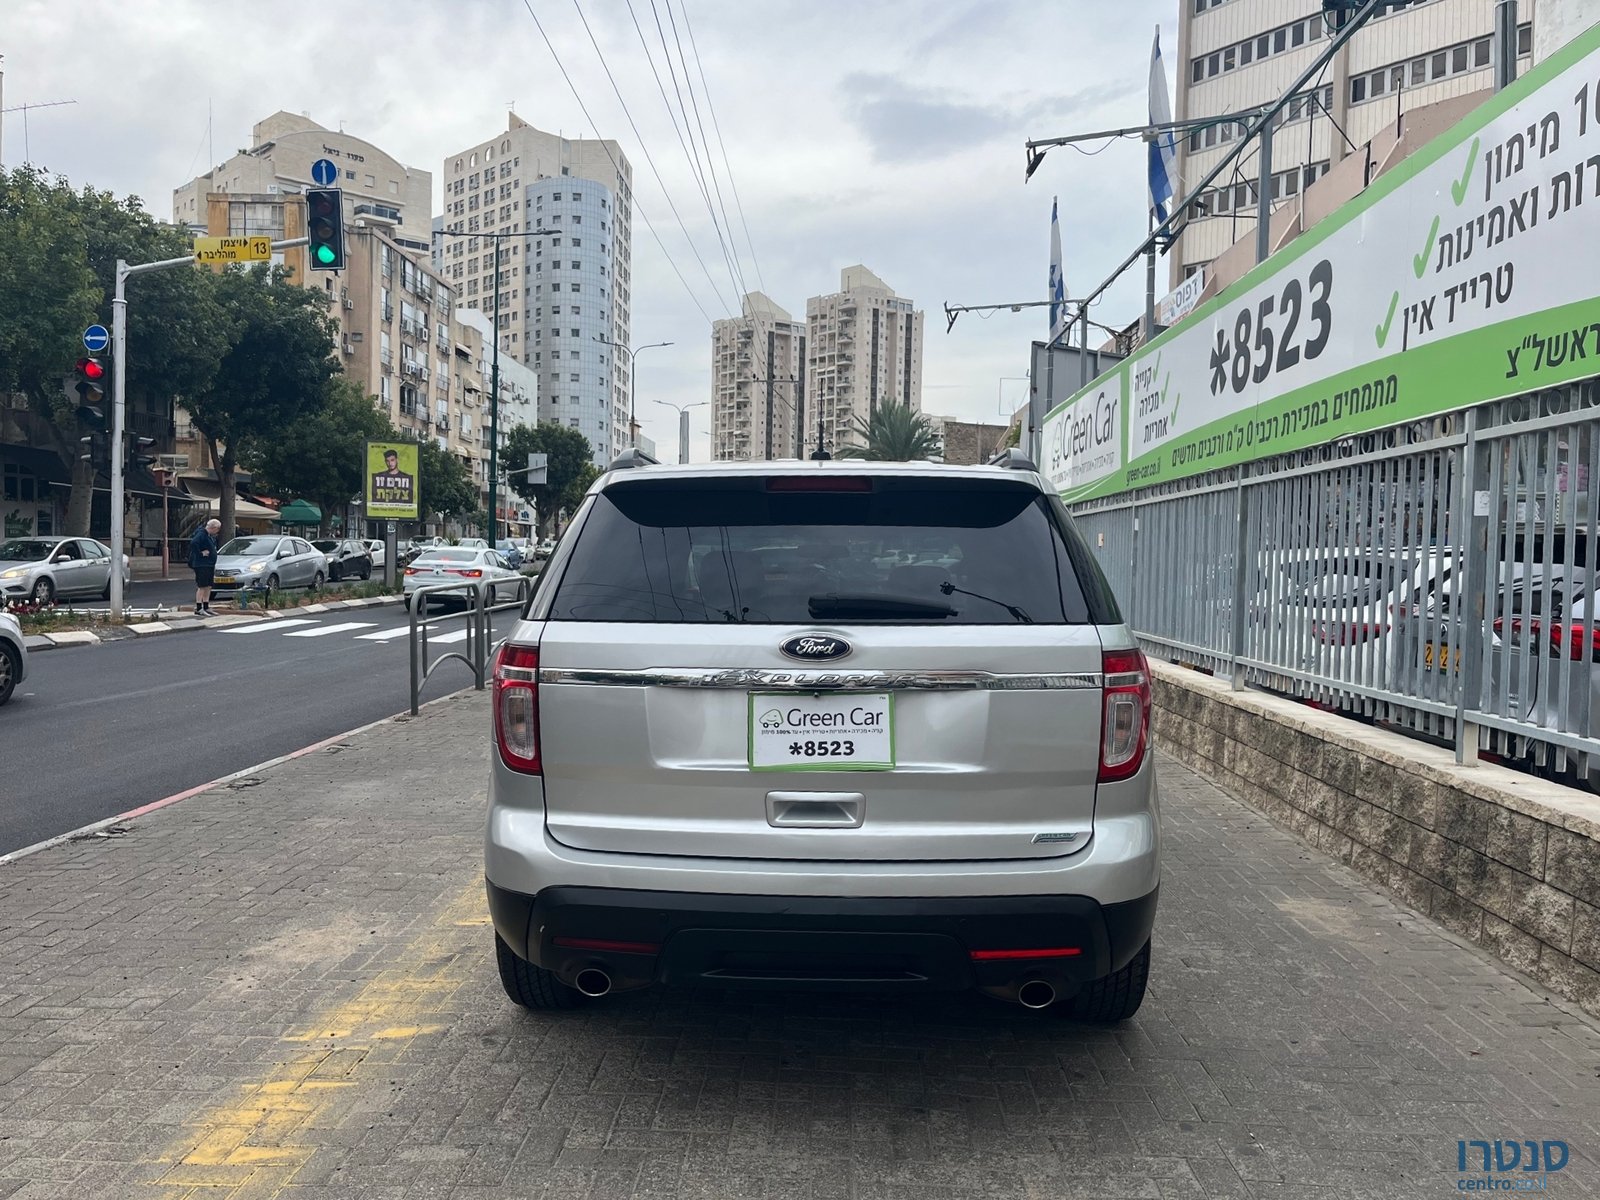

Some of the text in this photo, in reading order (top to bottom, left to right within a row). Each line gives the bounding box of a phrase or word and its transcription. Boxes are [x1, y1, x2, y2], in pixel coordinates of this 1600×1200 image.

[1485, 111, 1560, 203] מימון
[1435, 185, 1539, 274] ואמינות
[204, 249, 236, 259] מוהליבר
[220, 238, 242, 249] ויצמן
[254, 242, 267, 255] 13
[1175, 278, 1198, 308] דפוס
[1402, 261, 1514, 352] טרייד אין
[1134, 366, 1152, 392] קנייה
[1139, 391, 1160, 418] מכירה
[1332, 374, 1398, 420] מתמחים
[1062, 391, 1118, 461] Green Car
[1143, 415, 1169, 443] אחריות
[1256, 416, 1279, 444] רכבי
[1281, 398, 1328, 437] במכירת
[1198, 433, 1225, 460] ורכבים
[1246, 420, 1254, 447] 0
[1172, 443, 1196, 467] חדשים
[375, 476, 409, 488] חרם זו
[376, 487, 409, 502] צלקת
[796, 637, 836, 655] Ford
[716, 670, 920, 687] EXPLORER
[787, 707, 883, 727] Green Car
